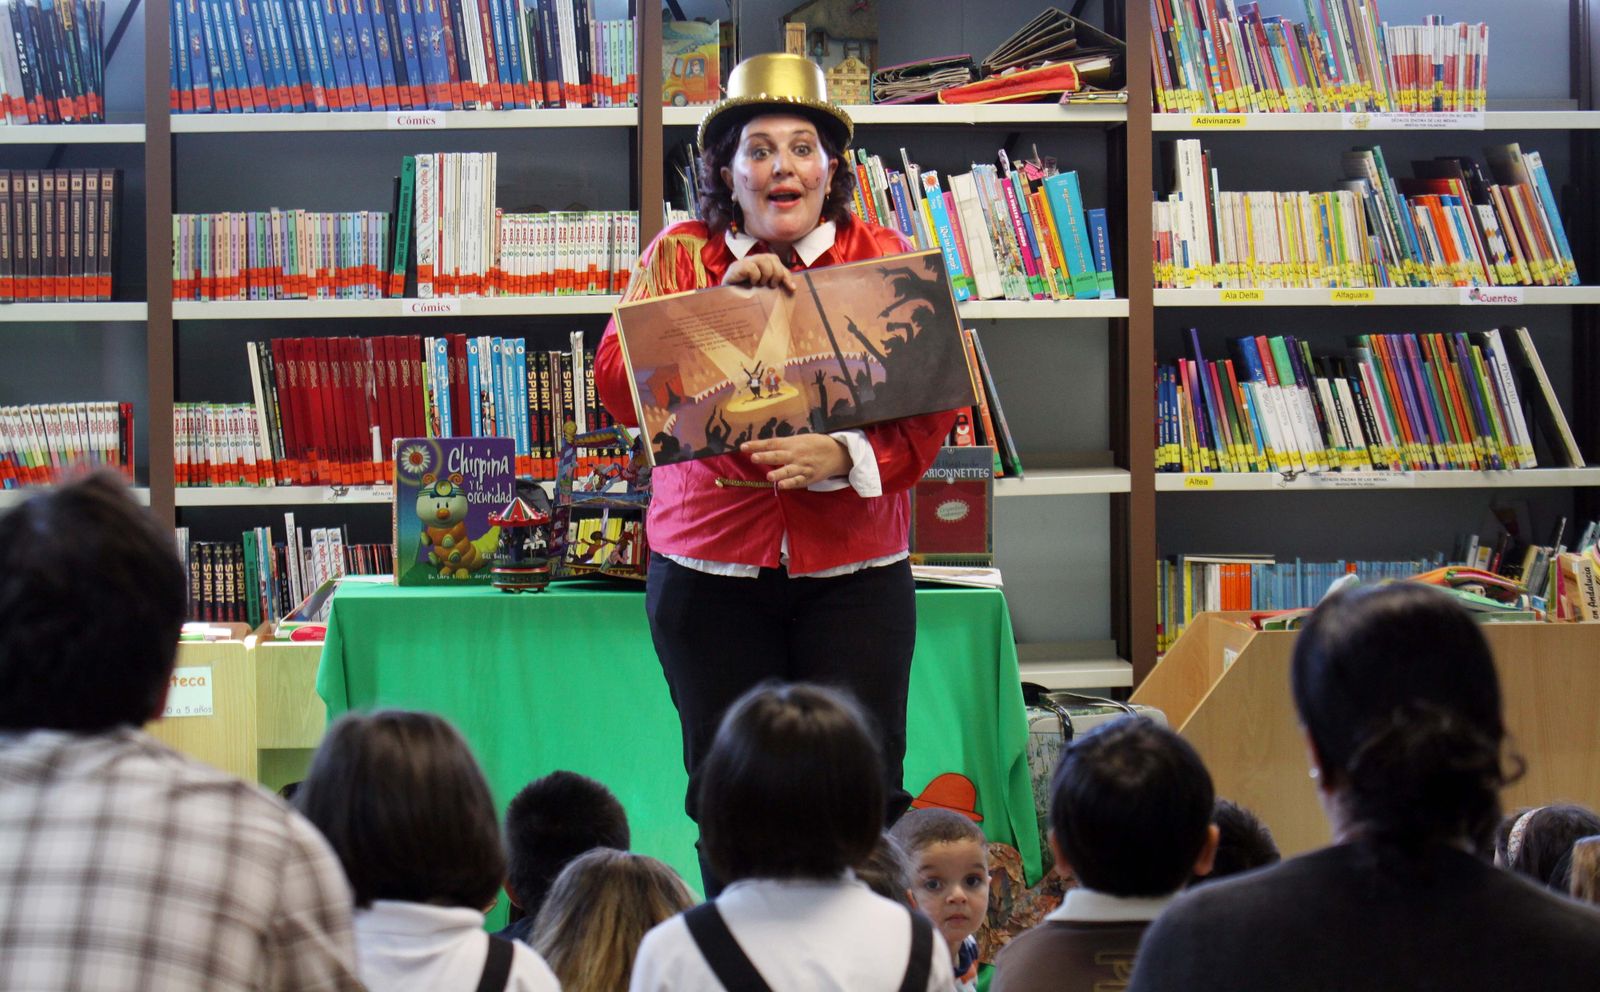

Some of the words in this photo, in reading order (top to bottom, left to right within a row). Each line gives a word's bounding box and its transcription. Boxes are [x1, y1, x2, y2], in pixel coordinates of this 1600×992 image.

[15, 32, 28, 75] BATMAN
[397, 115, 436, 126] Cómics
[1196, 117, 1241, 125] Adivinanzas
[1006, 187, 1014, 198] UNA
[1010, 199, 1019, 218] VUELTA
[1017, 227, 1027, 247] MUNDO
[411, 302, 451, 314] Cómics
[1224, 291, 1237, 300] Ala
[1239, 291, 1259, 300] Delta
[1335, 291, 1369, 301] Alfaguara
[1480, 293, 1518, 303] Cuentos
[528, 371, 537, 411] SPIRIT
[540, 371, 550, 410] SPIRIT
[563, 371, 572, 410] SPIRIT
[586, 370, 595, 409] SPIRIT
[1501, 363, 1518, 405] PINOCHO
[448, 443, 509, 483] Chispina
[922, 468, 990, 478] ARIONNETTES
[1189, 478, 1208, 486] Altea
[467, 483, 512, 505] oscuridad
[476, 481, 484, 492] la
[191, 562, 200, 601] SPIRIT
[204, 563, 212, 603] SPIRIT
[215, 564, 224, 603] SPIRIT
[225, 563, 234, 603] SPIRIT
[236, 562, 245, 601] SPIRIT
[1592, 610, 1599, 619] en
